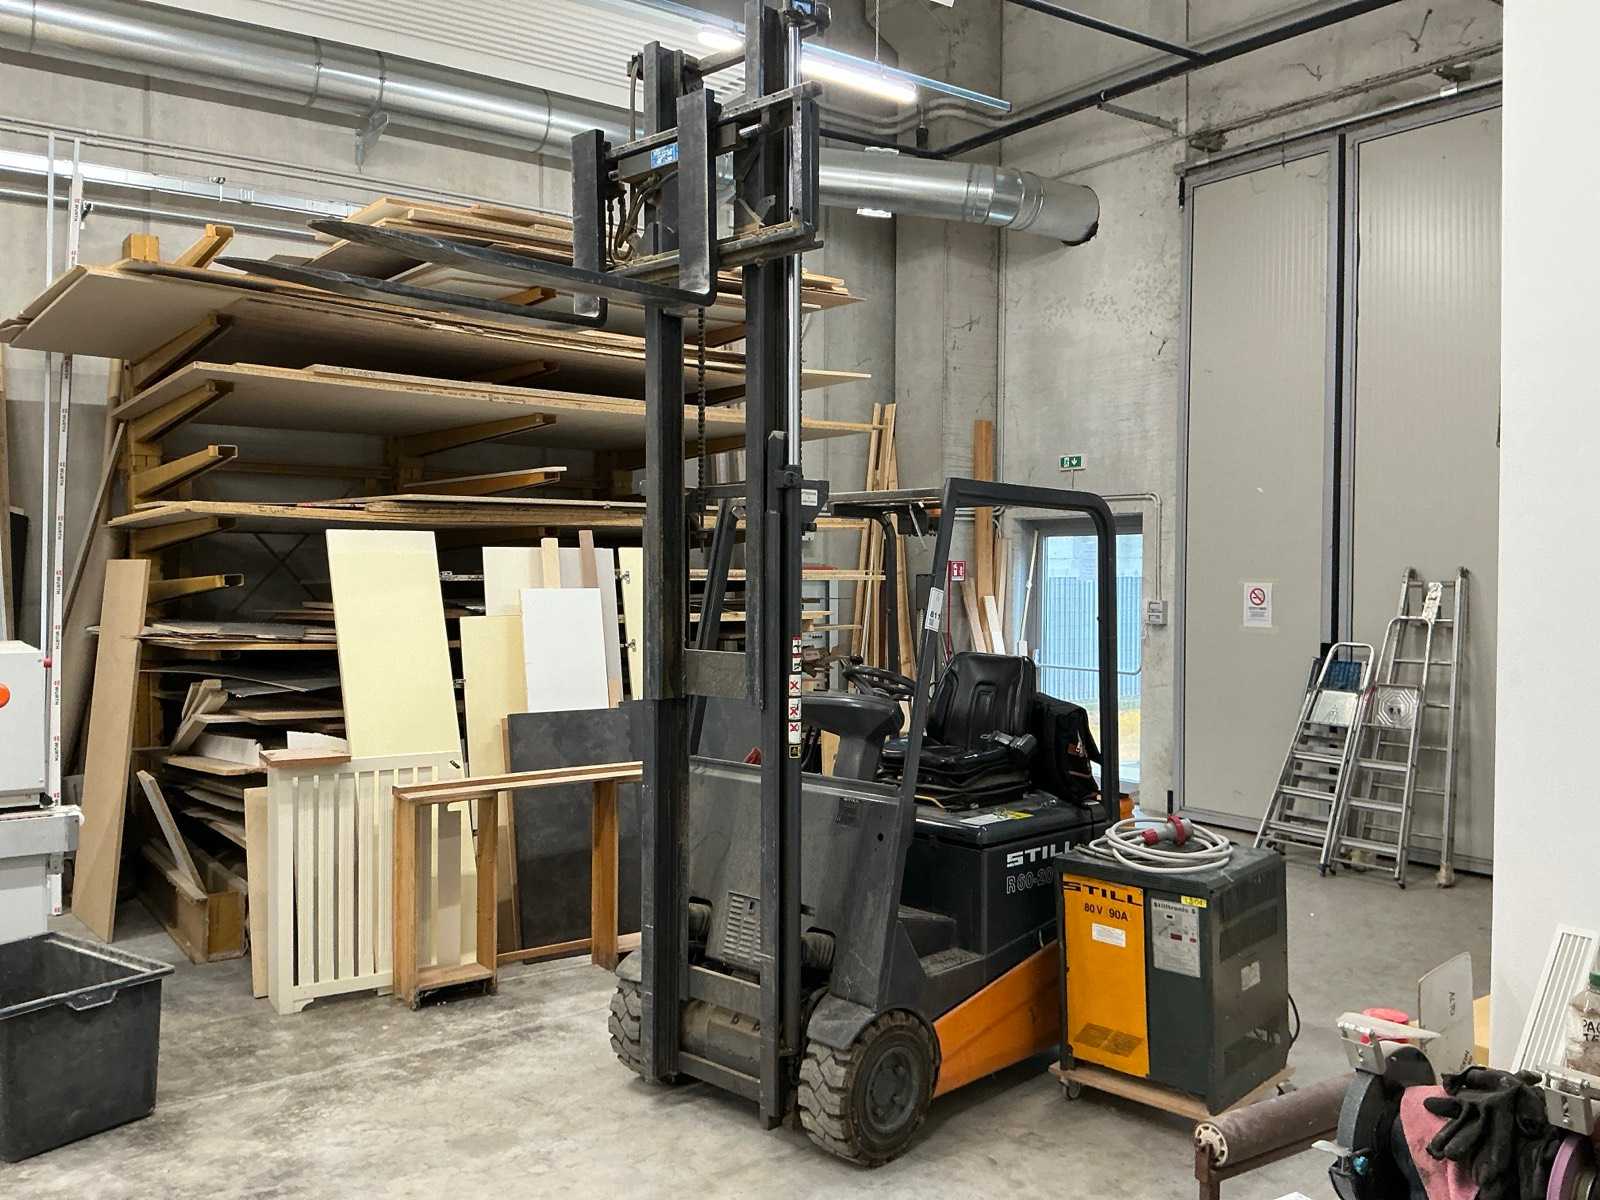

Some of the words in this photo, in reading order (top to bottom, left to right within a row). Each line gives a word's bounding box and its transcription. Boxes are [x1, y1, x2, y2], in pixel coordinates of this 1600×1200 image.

[1007, 841, 1073, 868] STILL
[1063, 880, 1143, 906] STILL
[1108, 906, 1128, 921] 90A
